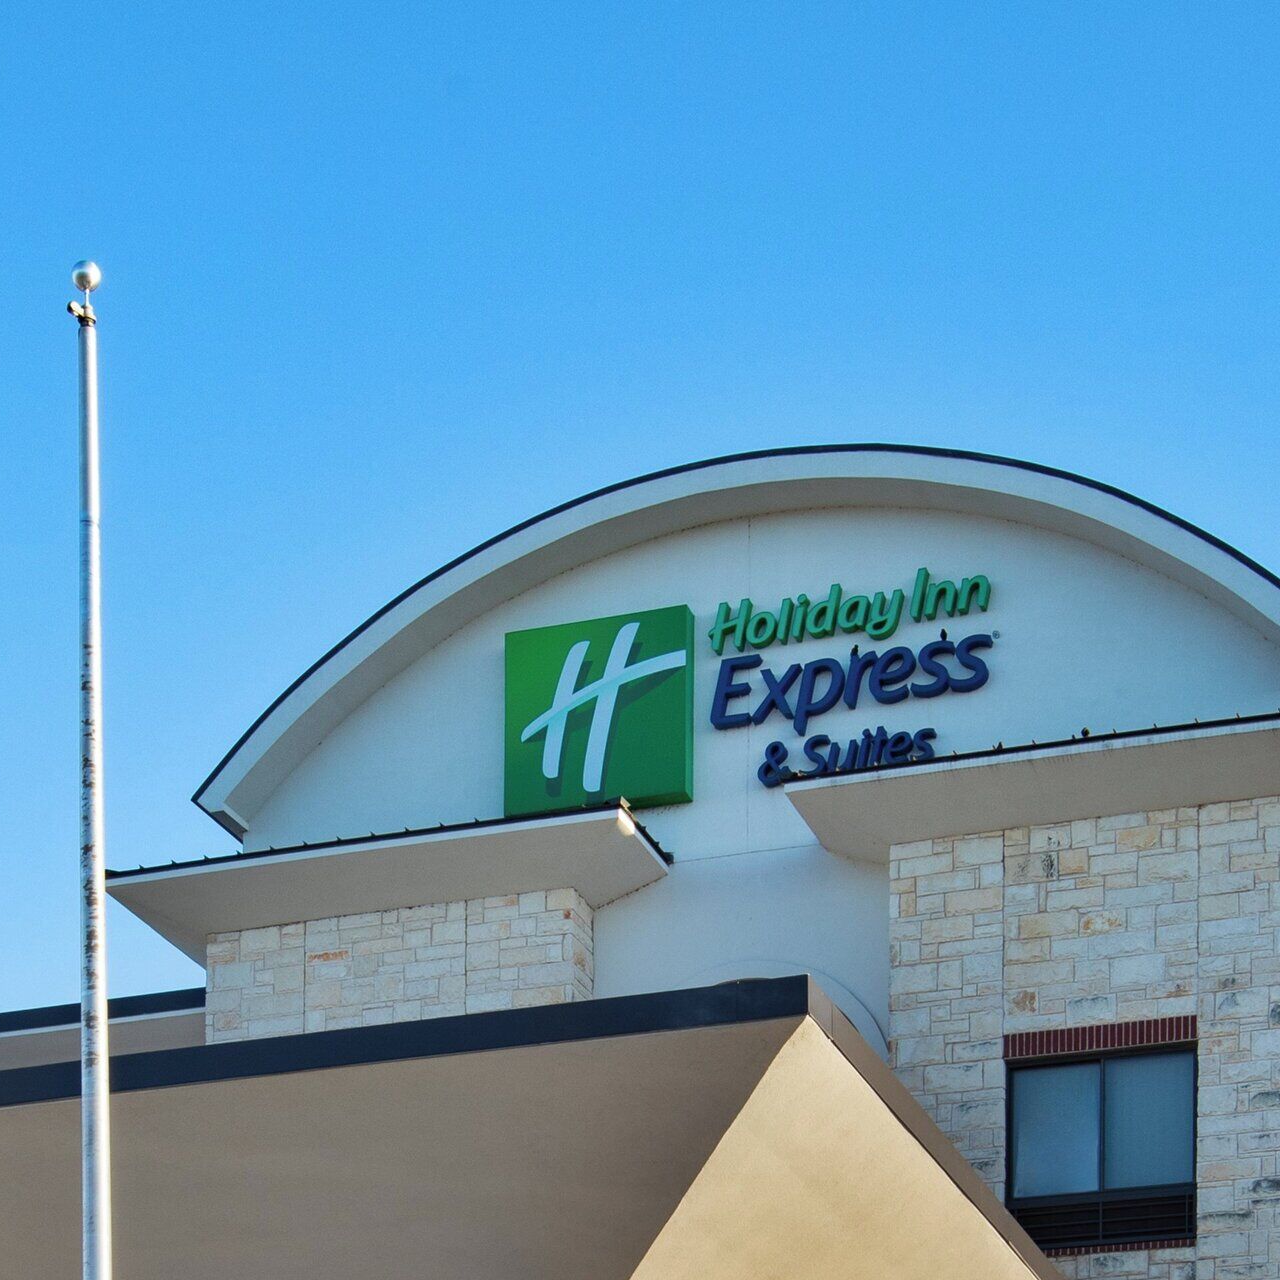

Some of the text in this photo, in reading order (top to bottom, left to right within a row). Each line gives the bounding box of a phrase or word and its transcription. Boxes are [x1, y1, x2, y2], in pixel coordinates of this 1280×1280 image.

[708, 567, 991, 656] Holiday Inn
[710, 633, 993, 737] Express
[757, 725, 937, 788] & Suites
